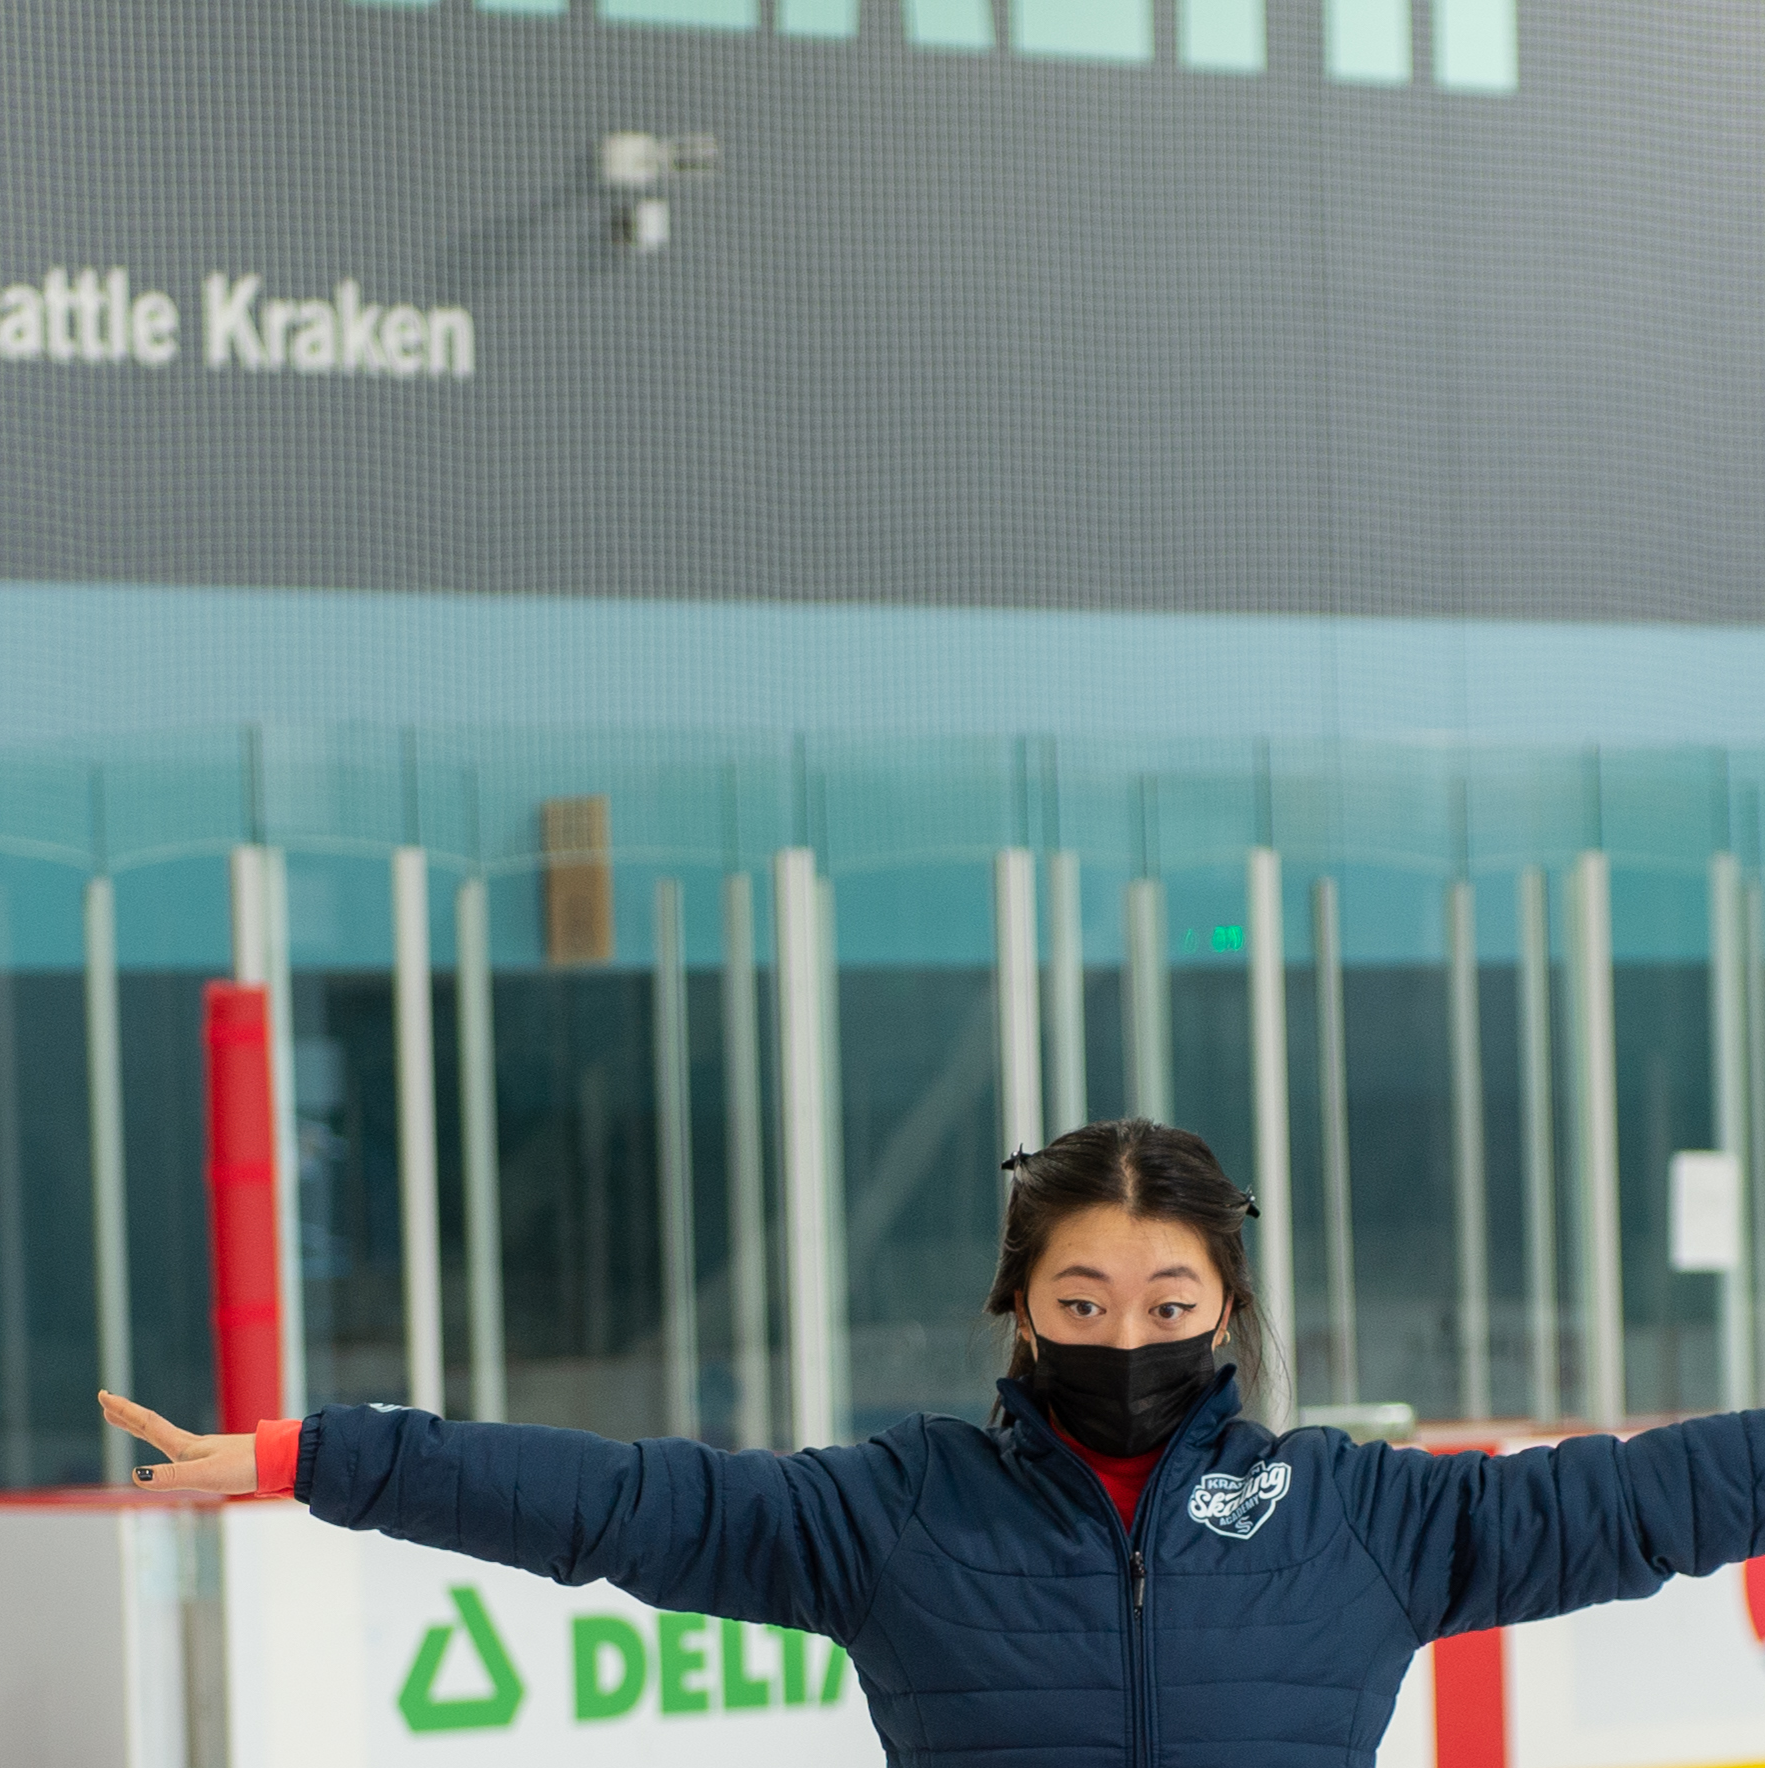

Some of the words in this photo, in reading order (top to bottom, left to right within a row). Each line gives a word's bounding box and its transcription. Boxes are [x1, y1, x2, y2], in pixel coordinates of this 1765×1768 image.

[205, 274, 474, 377] Kraken
[1219, 1494, 1260, 1526] ACADEMY
[571, 1611, 850, 1723] DELT
